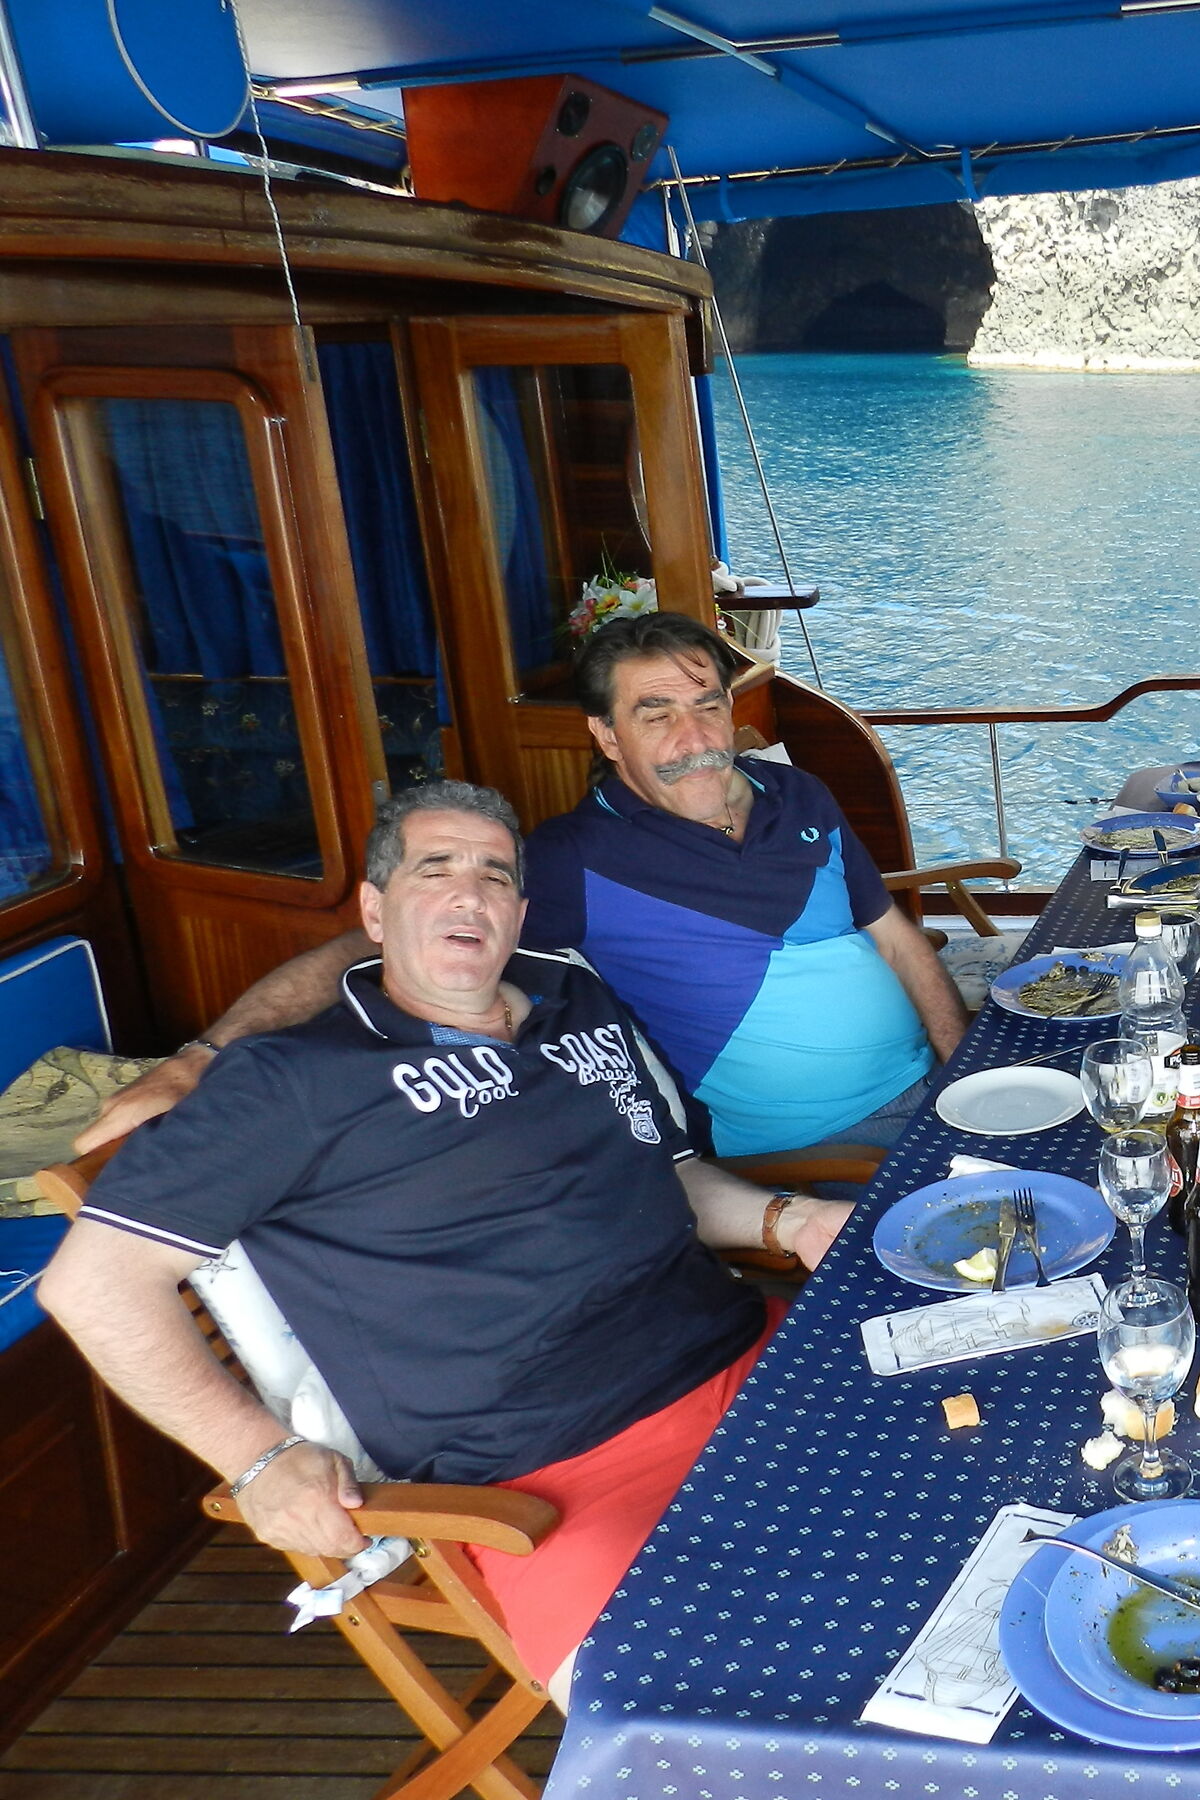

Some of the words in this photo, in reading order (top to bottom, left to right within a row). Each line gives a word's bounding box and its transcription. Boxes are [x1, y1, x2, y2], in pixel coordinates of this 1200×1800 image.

[393, 1046, 513, 1113] GOLD
[540, 1023, 637, 1073] COAST
[460, 1085, 520, 1118] Cool
